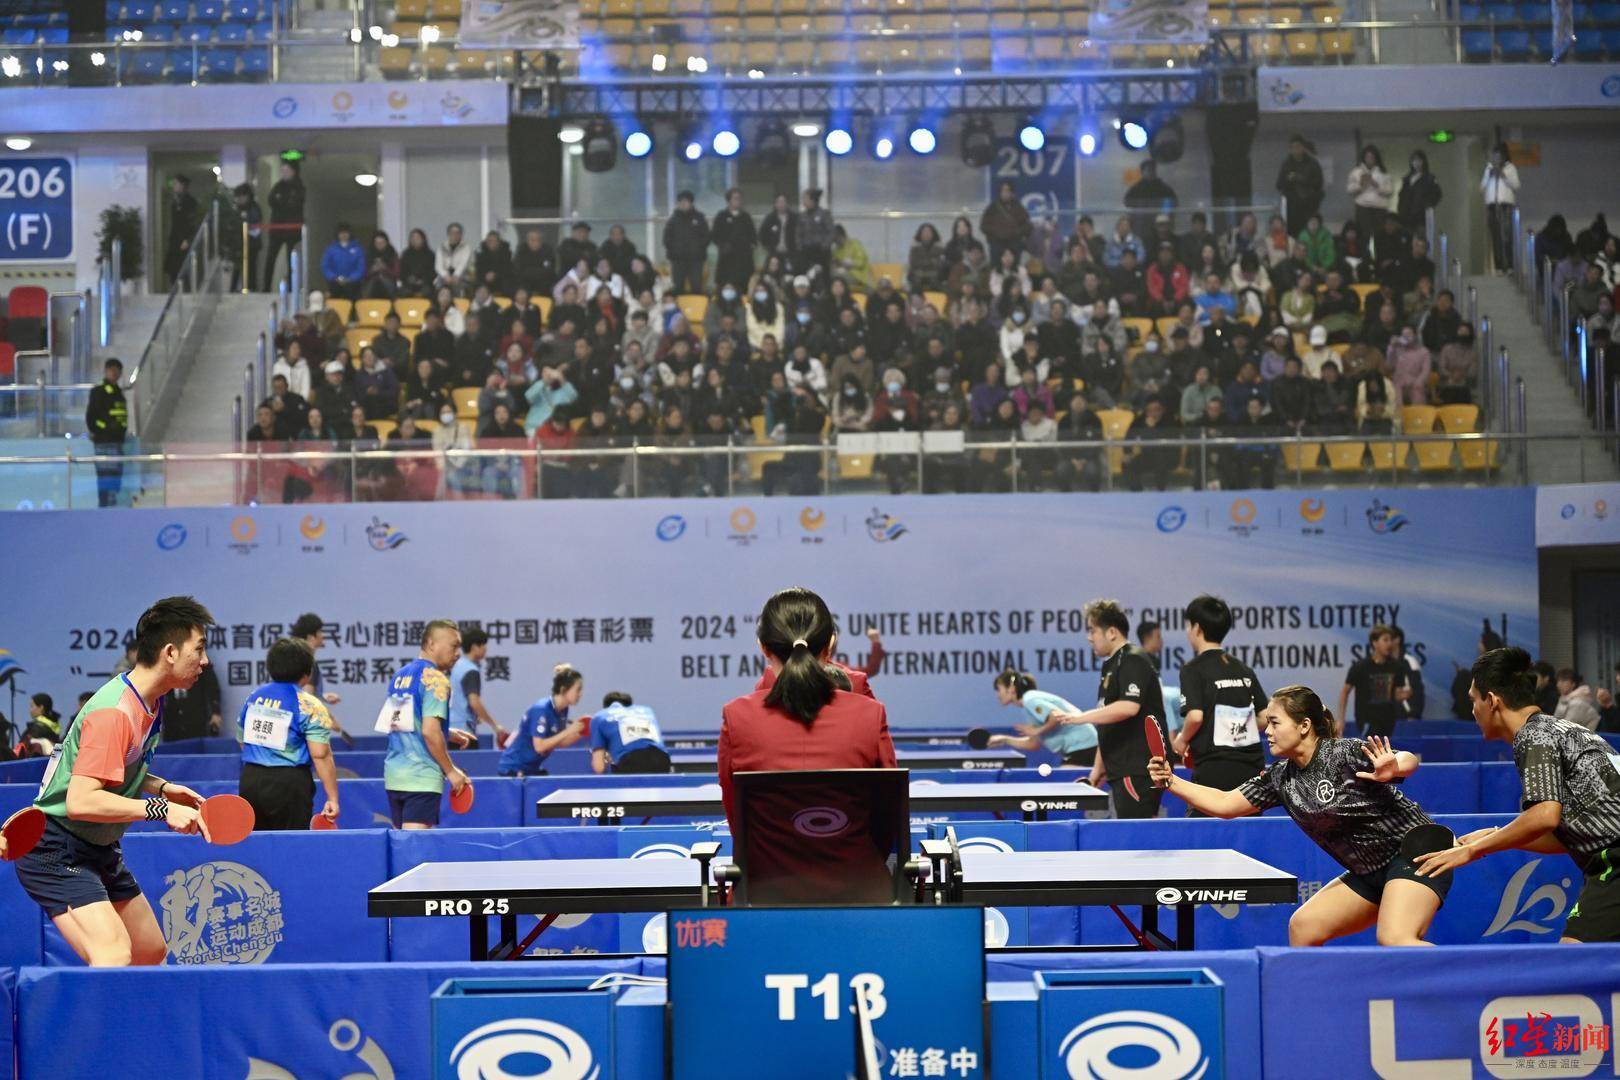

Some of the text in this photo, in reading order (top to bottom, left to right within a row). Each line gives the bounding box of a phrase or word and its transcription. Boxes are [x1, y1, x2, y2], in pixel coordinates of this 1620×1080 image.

[997, 145, 1067, 177] 207
[0, 167, 65, 198] 206
[7, 212, 52, 251] (F)
[681, 615, 737, 639] 2024
[848, 612, 910, 637] UNITE
[918, 610, 1001, 636] HEARTS
[1008, 610, 1034, 634] OF
[1231, 605, 1301, 631] PORTS
[1308, 604, 1400, 629] LOTTERY
[682, 655, 731, 679] BELT
[738, 654, 767, 678] AN
[857, 649, 1028, 676] ITERNATIONAL
[1036, 647, 1100, 672] TABLE
[572, 806, 625, 818] PRO 25
[1038, 801, 1078, 810] YINHE
[425, 898, 510, 916] PRO 25
[1184, 889, 1248, 902] YINHE
[889, 1046, 978, 1078] 准备中
